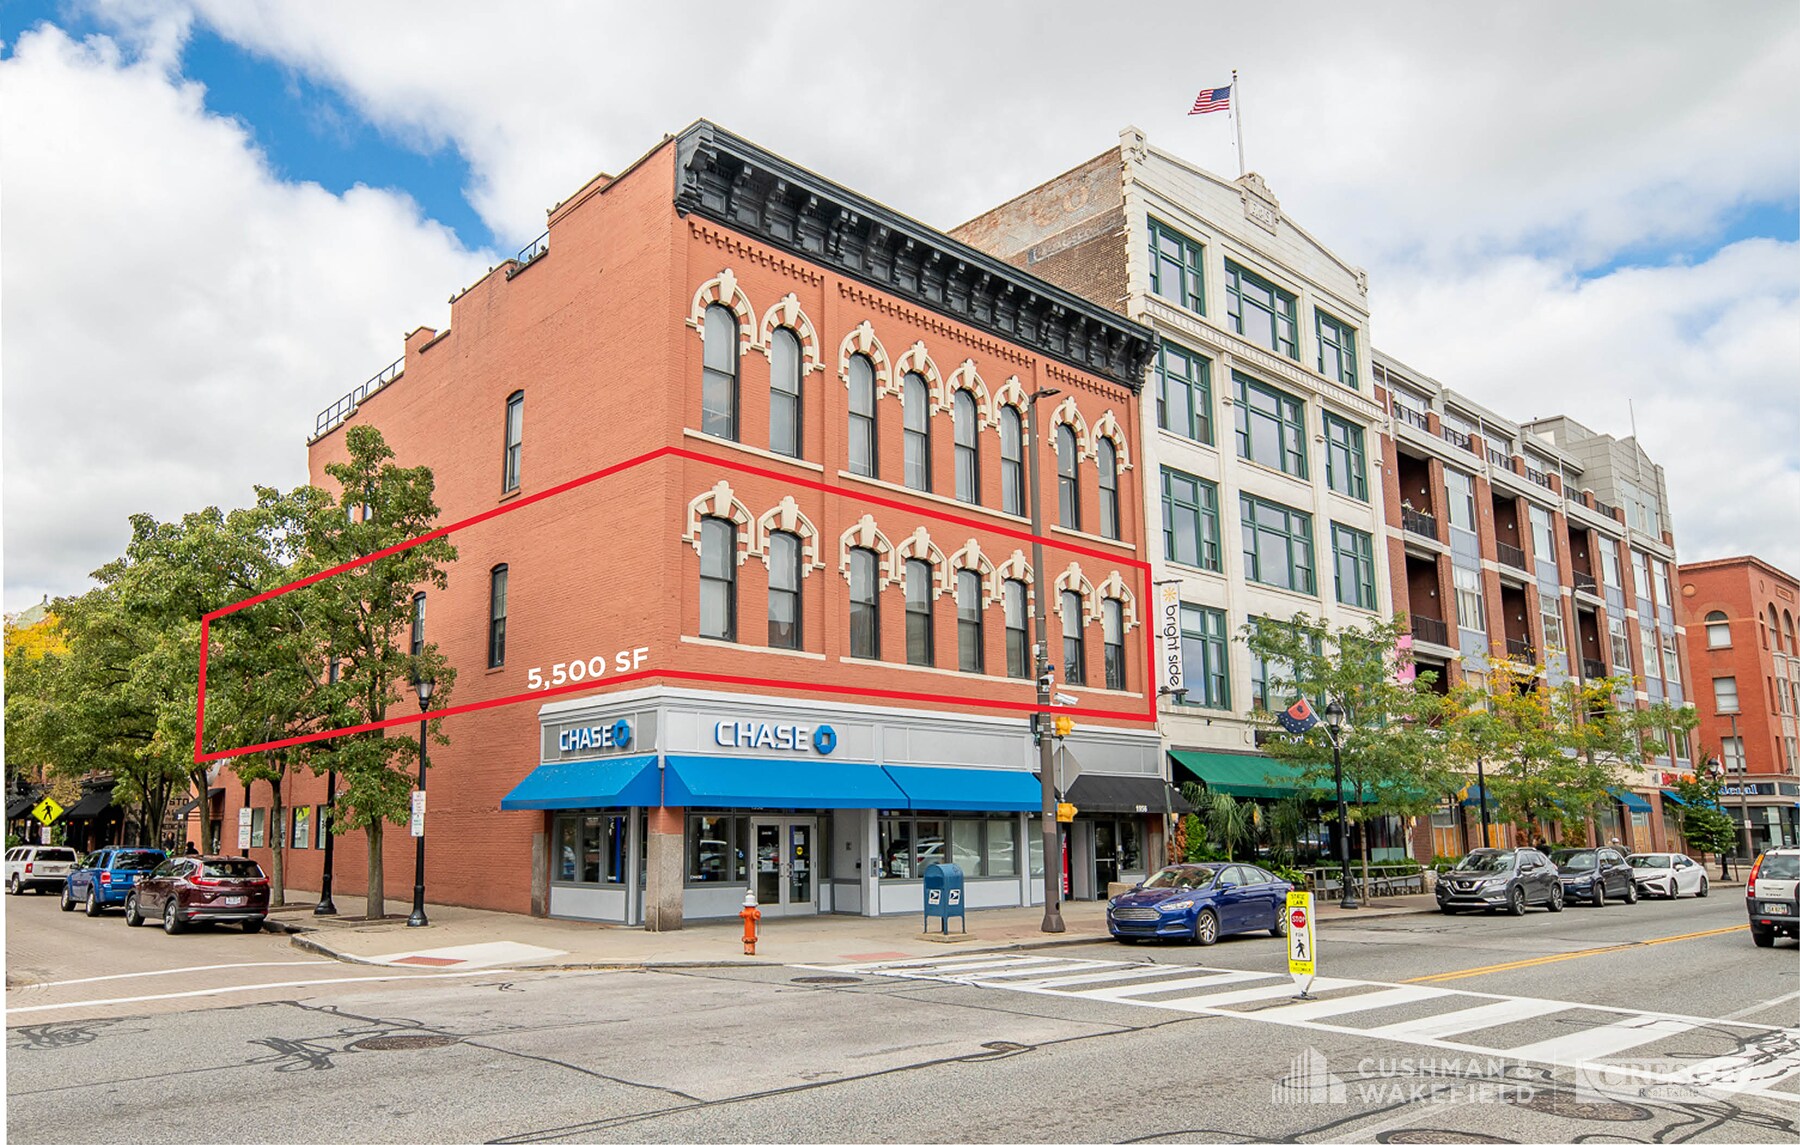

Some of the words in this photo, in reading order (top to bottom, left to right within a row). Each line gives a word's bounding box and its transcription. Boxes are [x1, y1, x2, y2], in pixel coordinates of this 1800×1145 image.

[1163, 604, 1180, 651] bright
[1168, 654, 1182, 687] side
[560, 724, 613, 752] CHASE
[715, 721, 810, 751] CHASE
[1291, 915, 1306, 923] STOP
